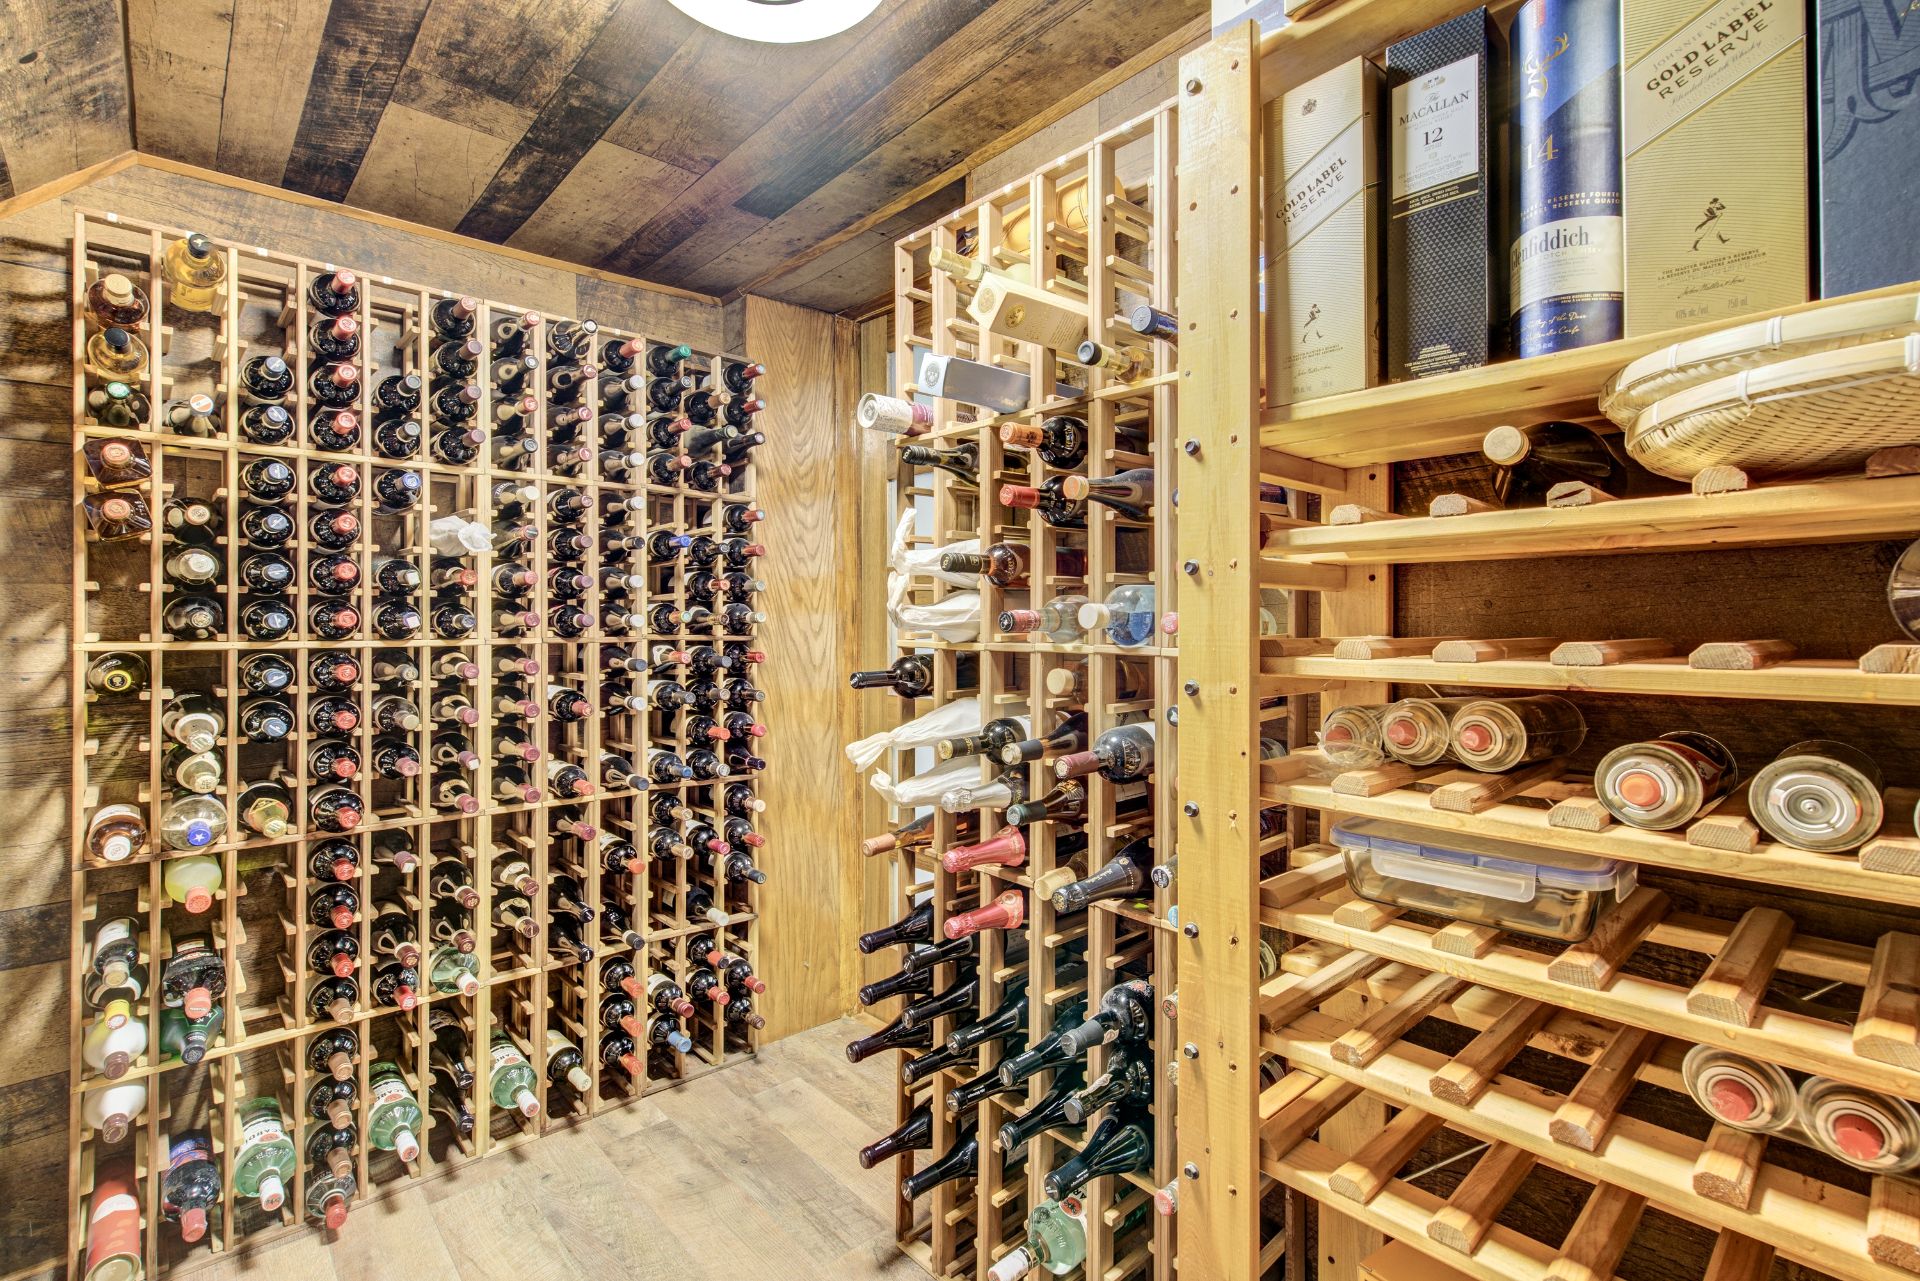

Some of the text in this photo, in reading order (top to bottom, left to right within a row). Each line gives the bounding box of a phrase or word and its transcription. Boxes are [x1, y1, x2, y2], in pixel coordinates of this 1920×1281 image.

[1646, 0, 1773, 91] GOLD LABEL
[1658, 19, 1768, 99] RESERVE
[1399, 90, 1470, 127] MACALLAN
[1423, 127, 1444, 147] 12
[1524, 134, 1559, 171] 14
[1276, 157, 1347, 219] GOLD LABEL
[1283, 171, 1344, 226] RESERVE
[1511, 225, 1589, 271] Glenfiddich
